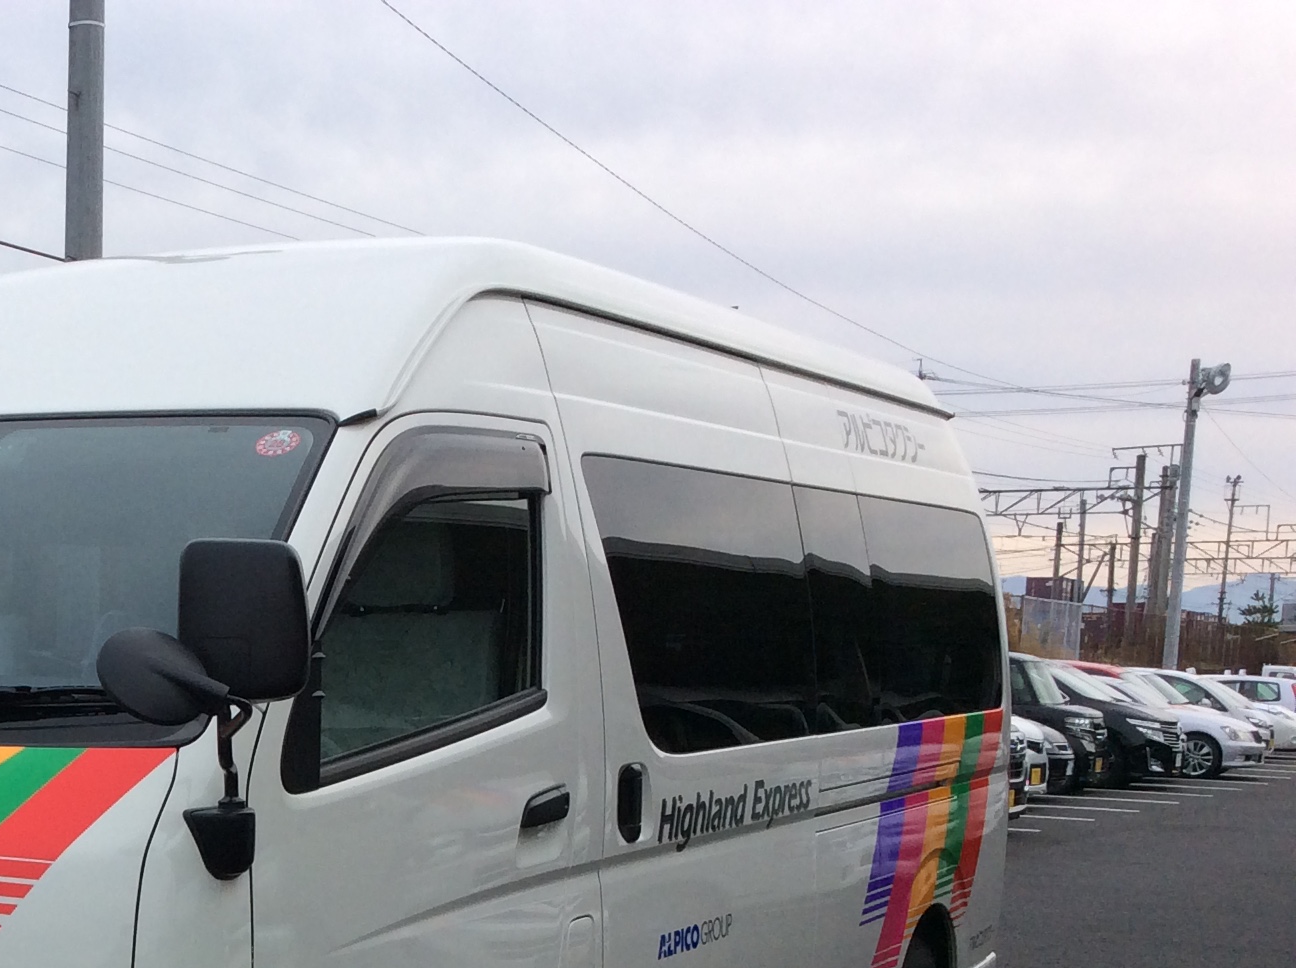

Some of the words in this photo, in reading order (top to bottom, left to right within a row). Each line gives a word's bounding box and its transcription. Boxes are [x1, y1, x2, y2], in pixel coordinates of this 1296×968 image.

[836, 409, 926, 463] アルピコタクシー
[657, 783, 749, 852] Highland
[750, 779, 812, 830] Express
